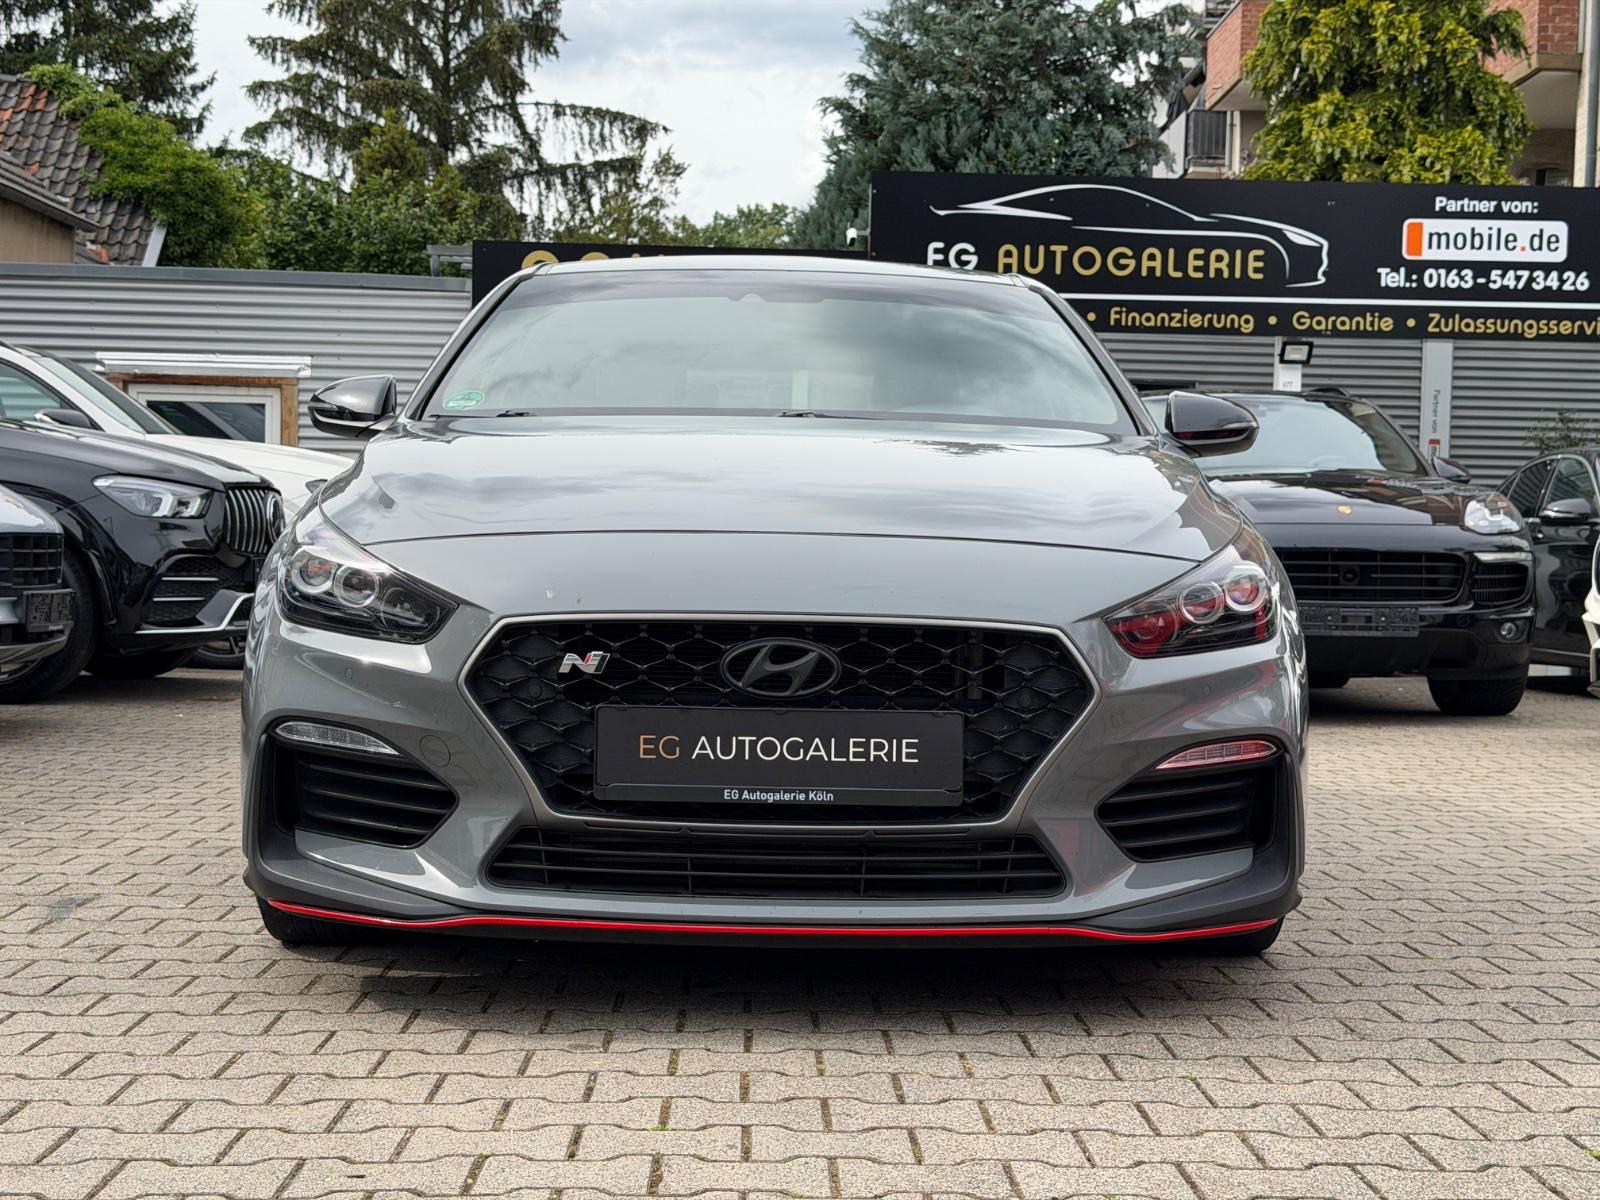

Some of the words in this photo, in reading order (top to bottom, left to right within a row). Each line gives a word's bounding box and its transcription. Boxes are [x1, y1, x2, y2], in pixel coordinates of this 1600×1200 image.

[1434, 196, 1498, 214] Partner
[1501, 200, 1539, 214] von:
[1427, 227, 1561, 252] mobile.de
[997, 244, 1265, 279] AUTOGALERIE
[1377, 267, 1417, 288] Tel.:
[1109, 306, 1255, 334] Finanzierung
[1292, 310, 1395, 333] Garantie
[638, 734, 681, 760] EG
[691, 735, 920, 763] AUTOGALERIE
[723, 789, 739, 800] EG
[741, 789, 806, 803] Autogalerie
[808, 790, 834, 802] Köln
